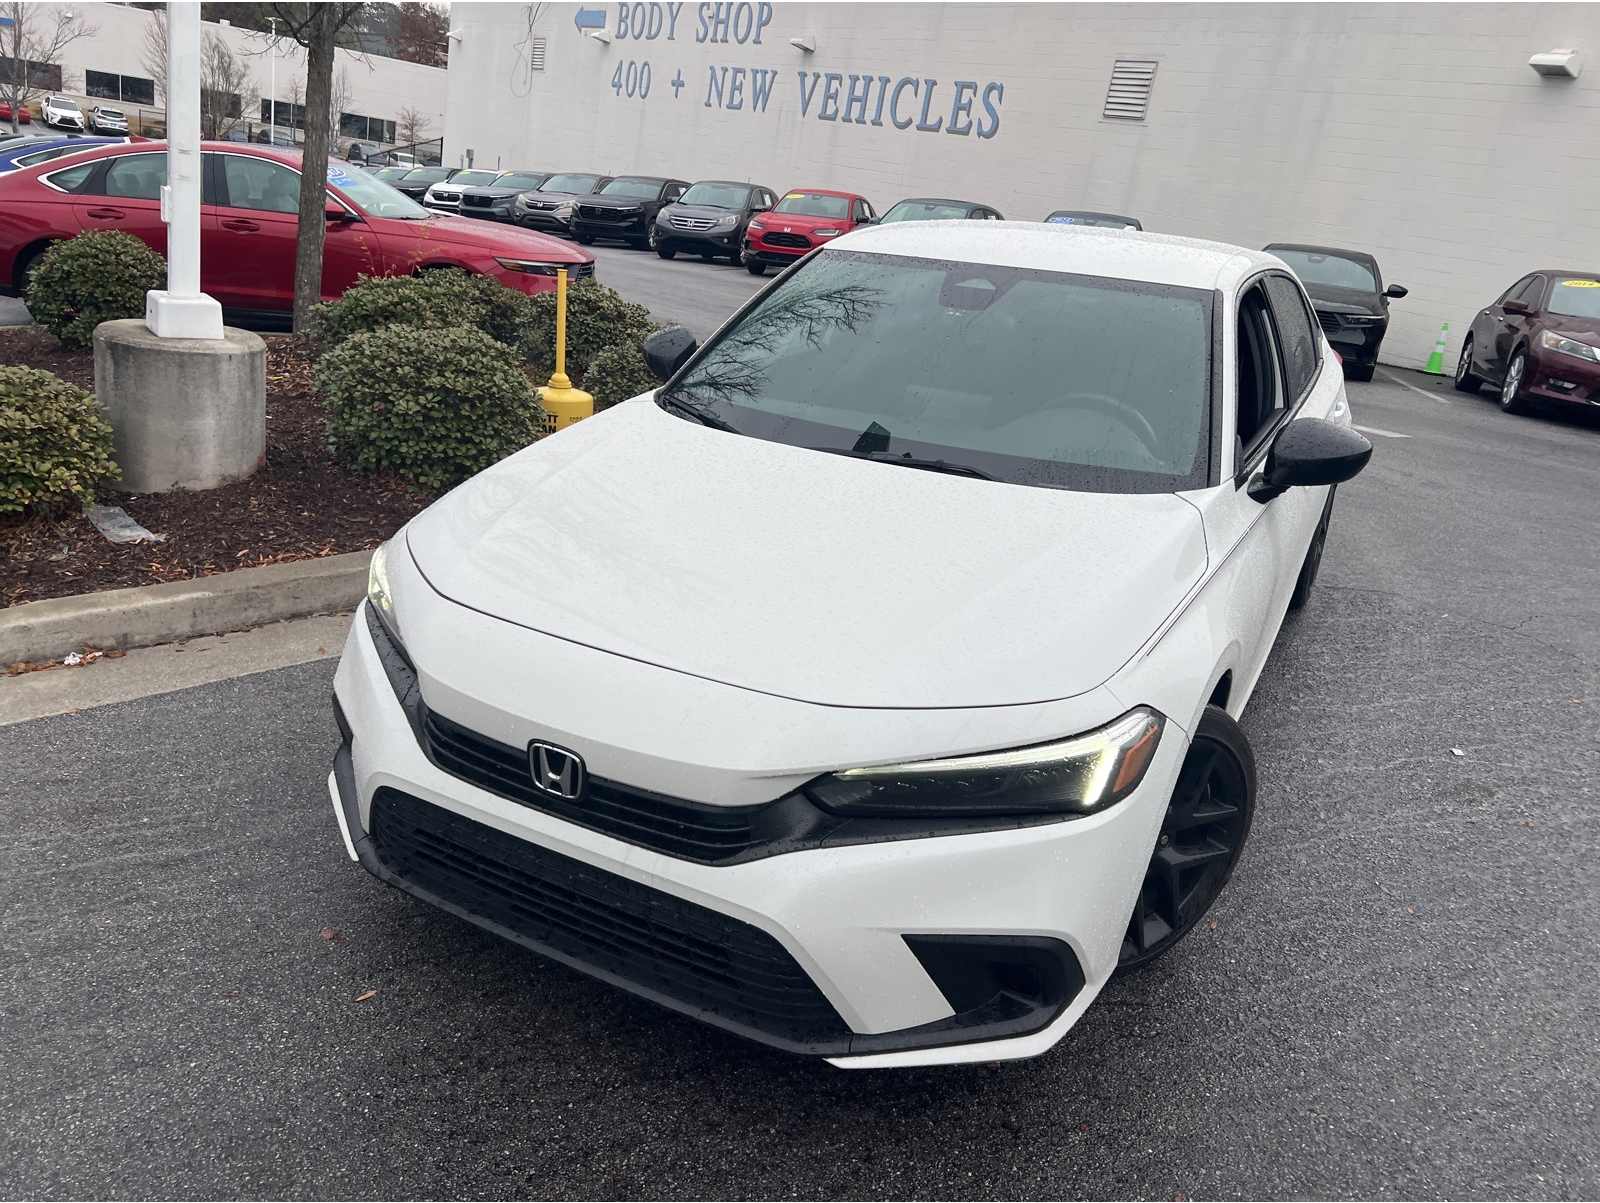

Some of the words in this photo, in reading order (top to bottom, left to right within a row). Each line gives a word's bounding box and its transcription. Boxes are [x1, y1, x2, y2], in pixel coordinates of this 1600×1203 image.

[615, 2, 683, 40] BODY
[696, 2, 773, 44] SHOP
[611, 59, 651, 99] 400
[671, 68, 685, 99] +
[704, 65, 778, 113] NEW
[797, 71, 1004, 139] VEHICLES
